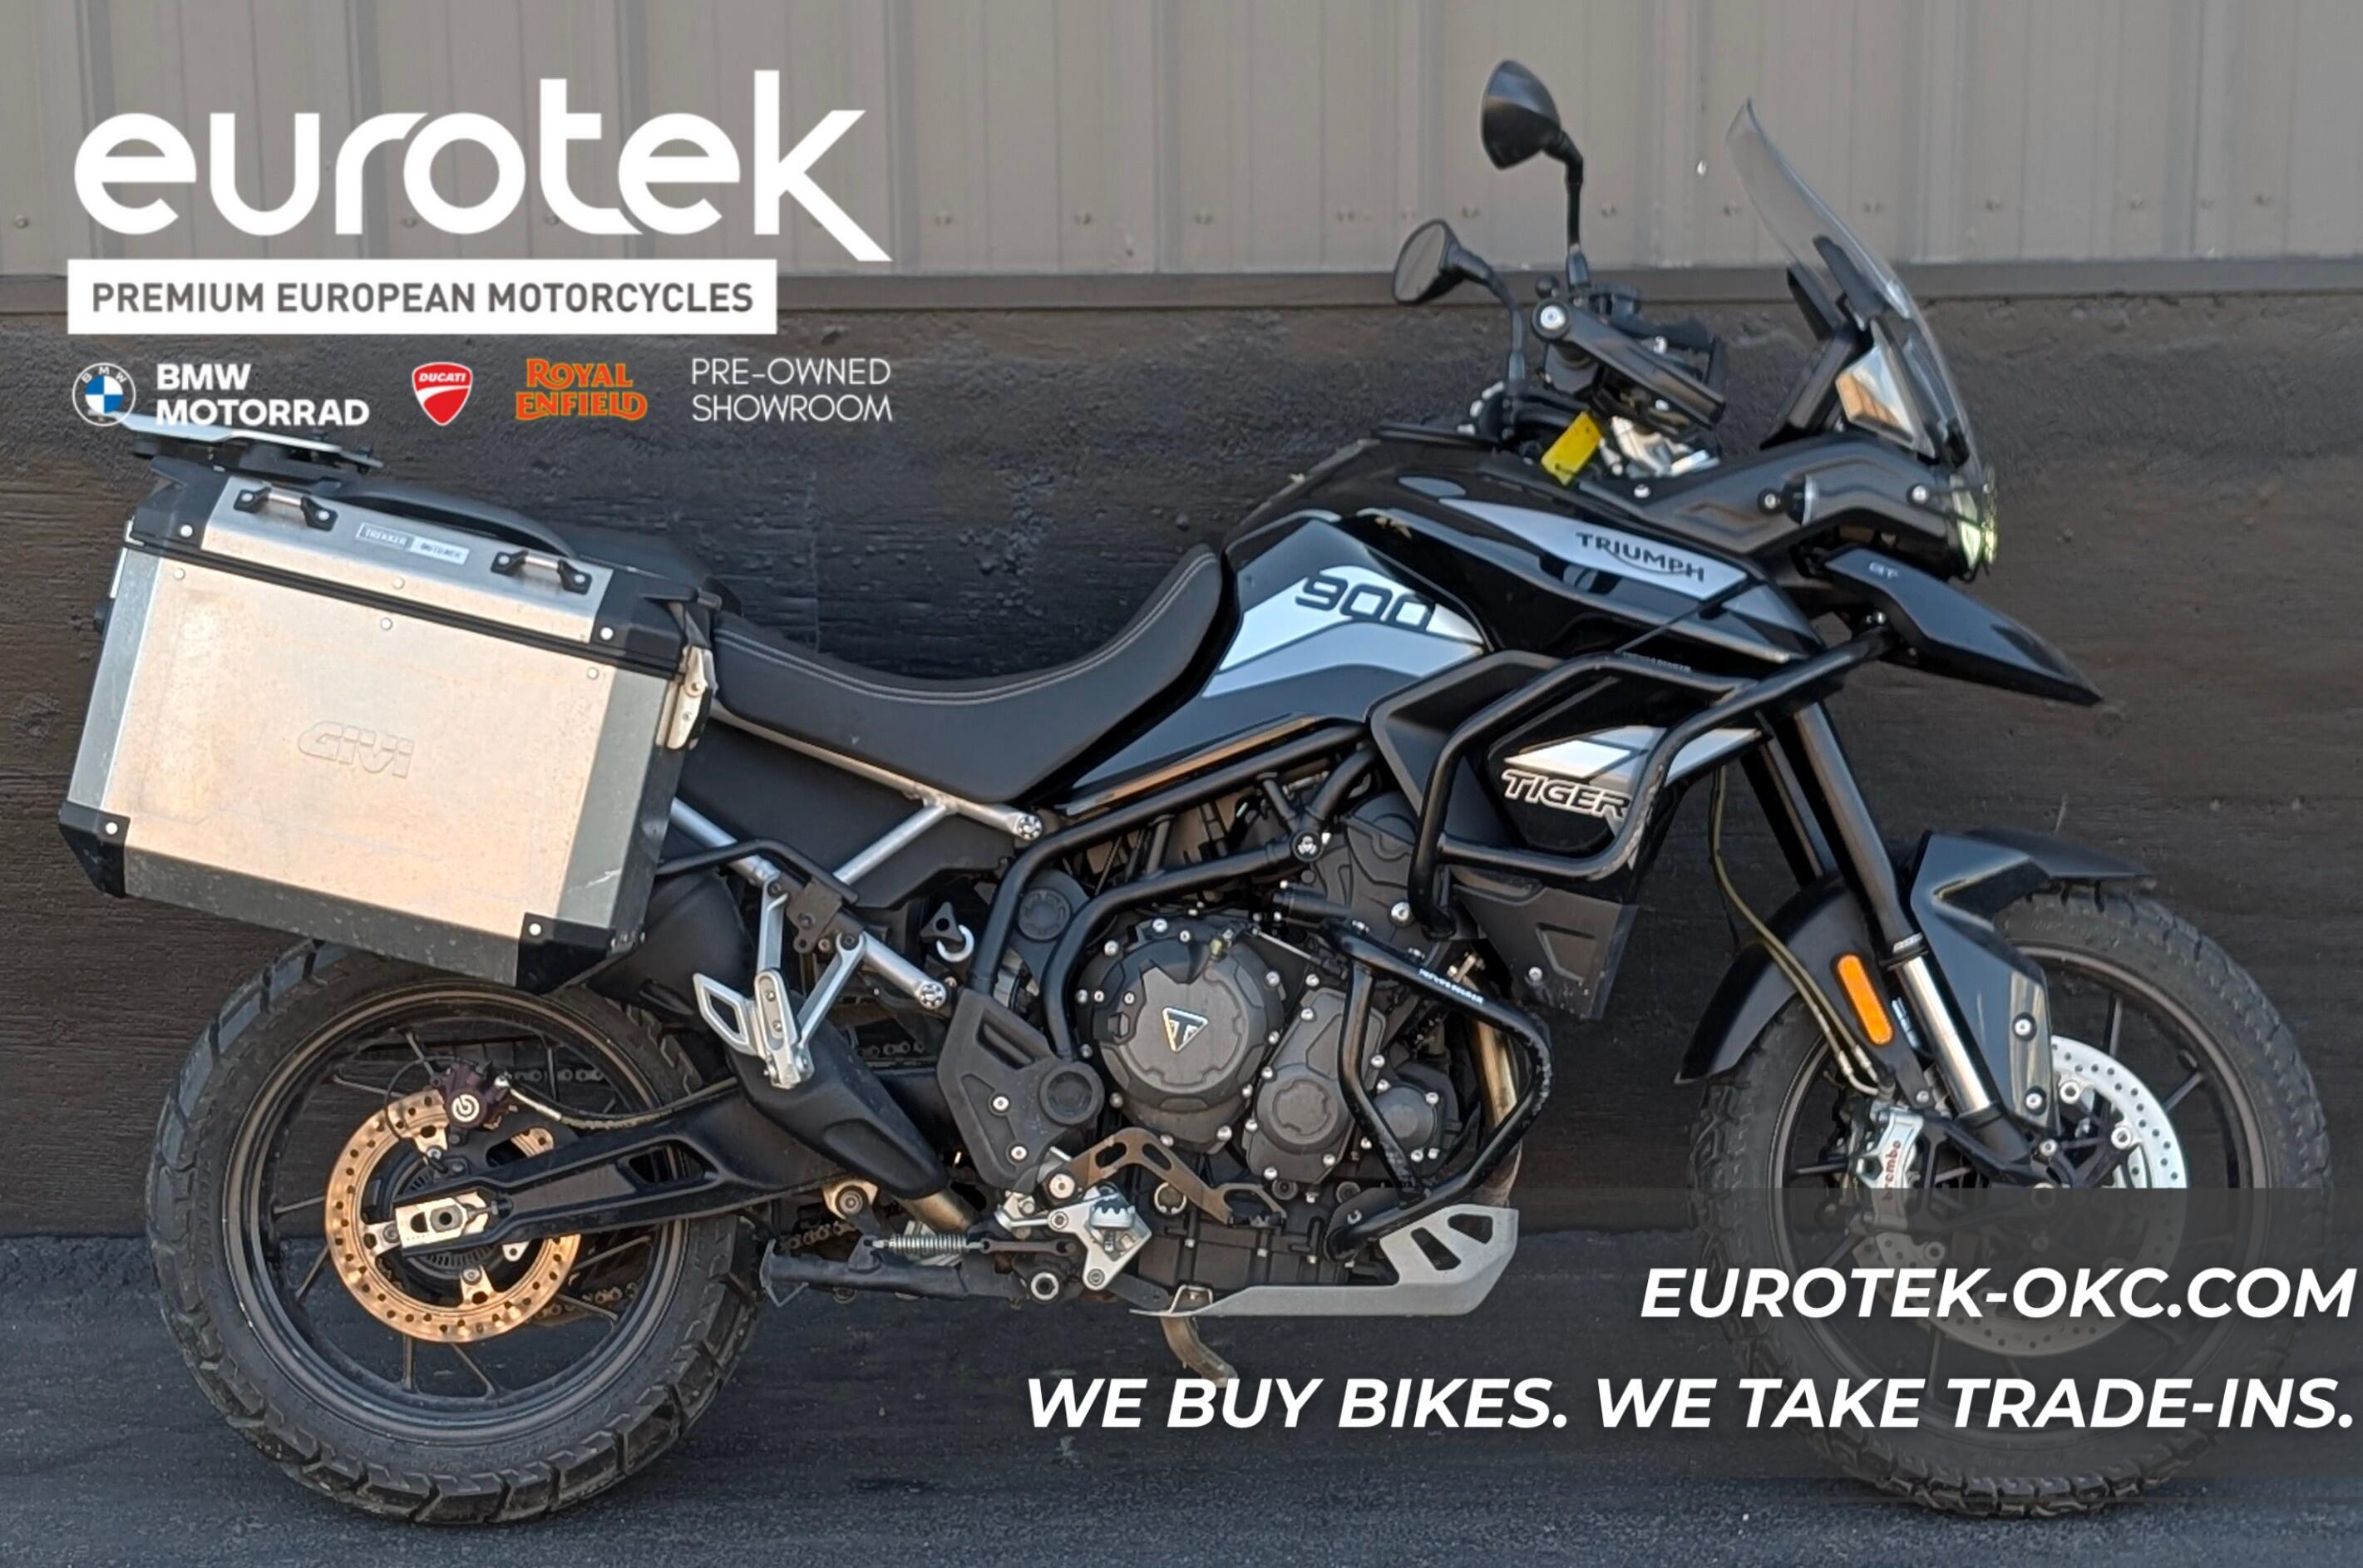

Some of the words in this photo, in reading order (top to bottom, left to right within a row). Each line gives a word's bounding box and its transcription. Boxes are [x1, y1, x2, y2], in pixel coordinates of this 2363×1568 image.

[1576, 531, 1704, 583] TRIUMPH
[1294, 574, 1436, 633] 900
[298, 720, 414, 780] GIVI
[1502, 768, 1633, 819] TIGER
[1882, 1140, 1902, 1201] brembo
